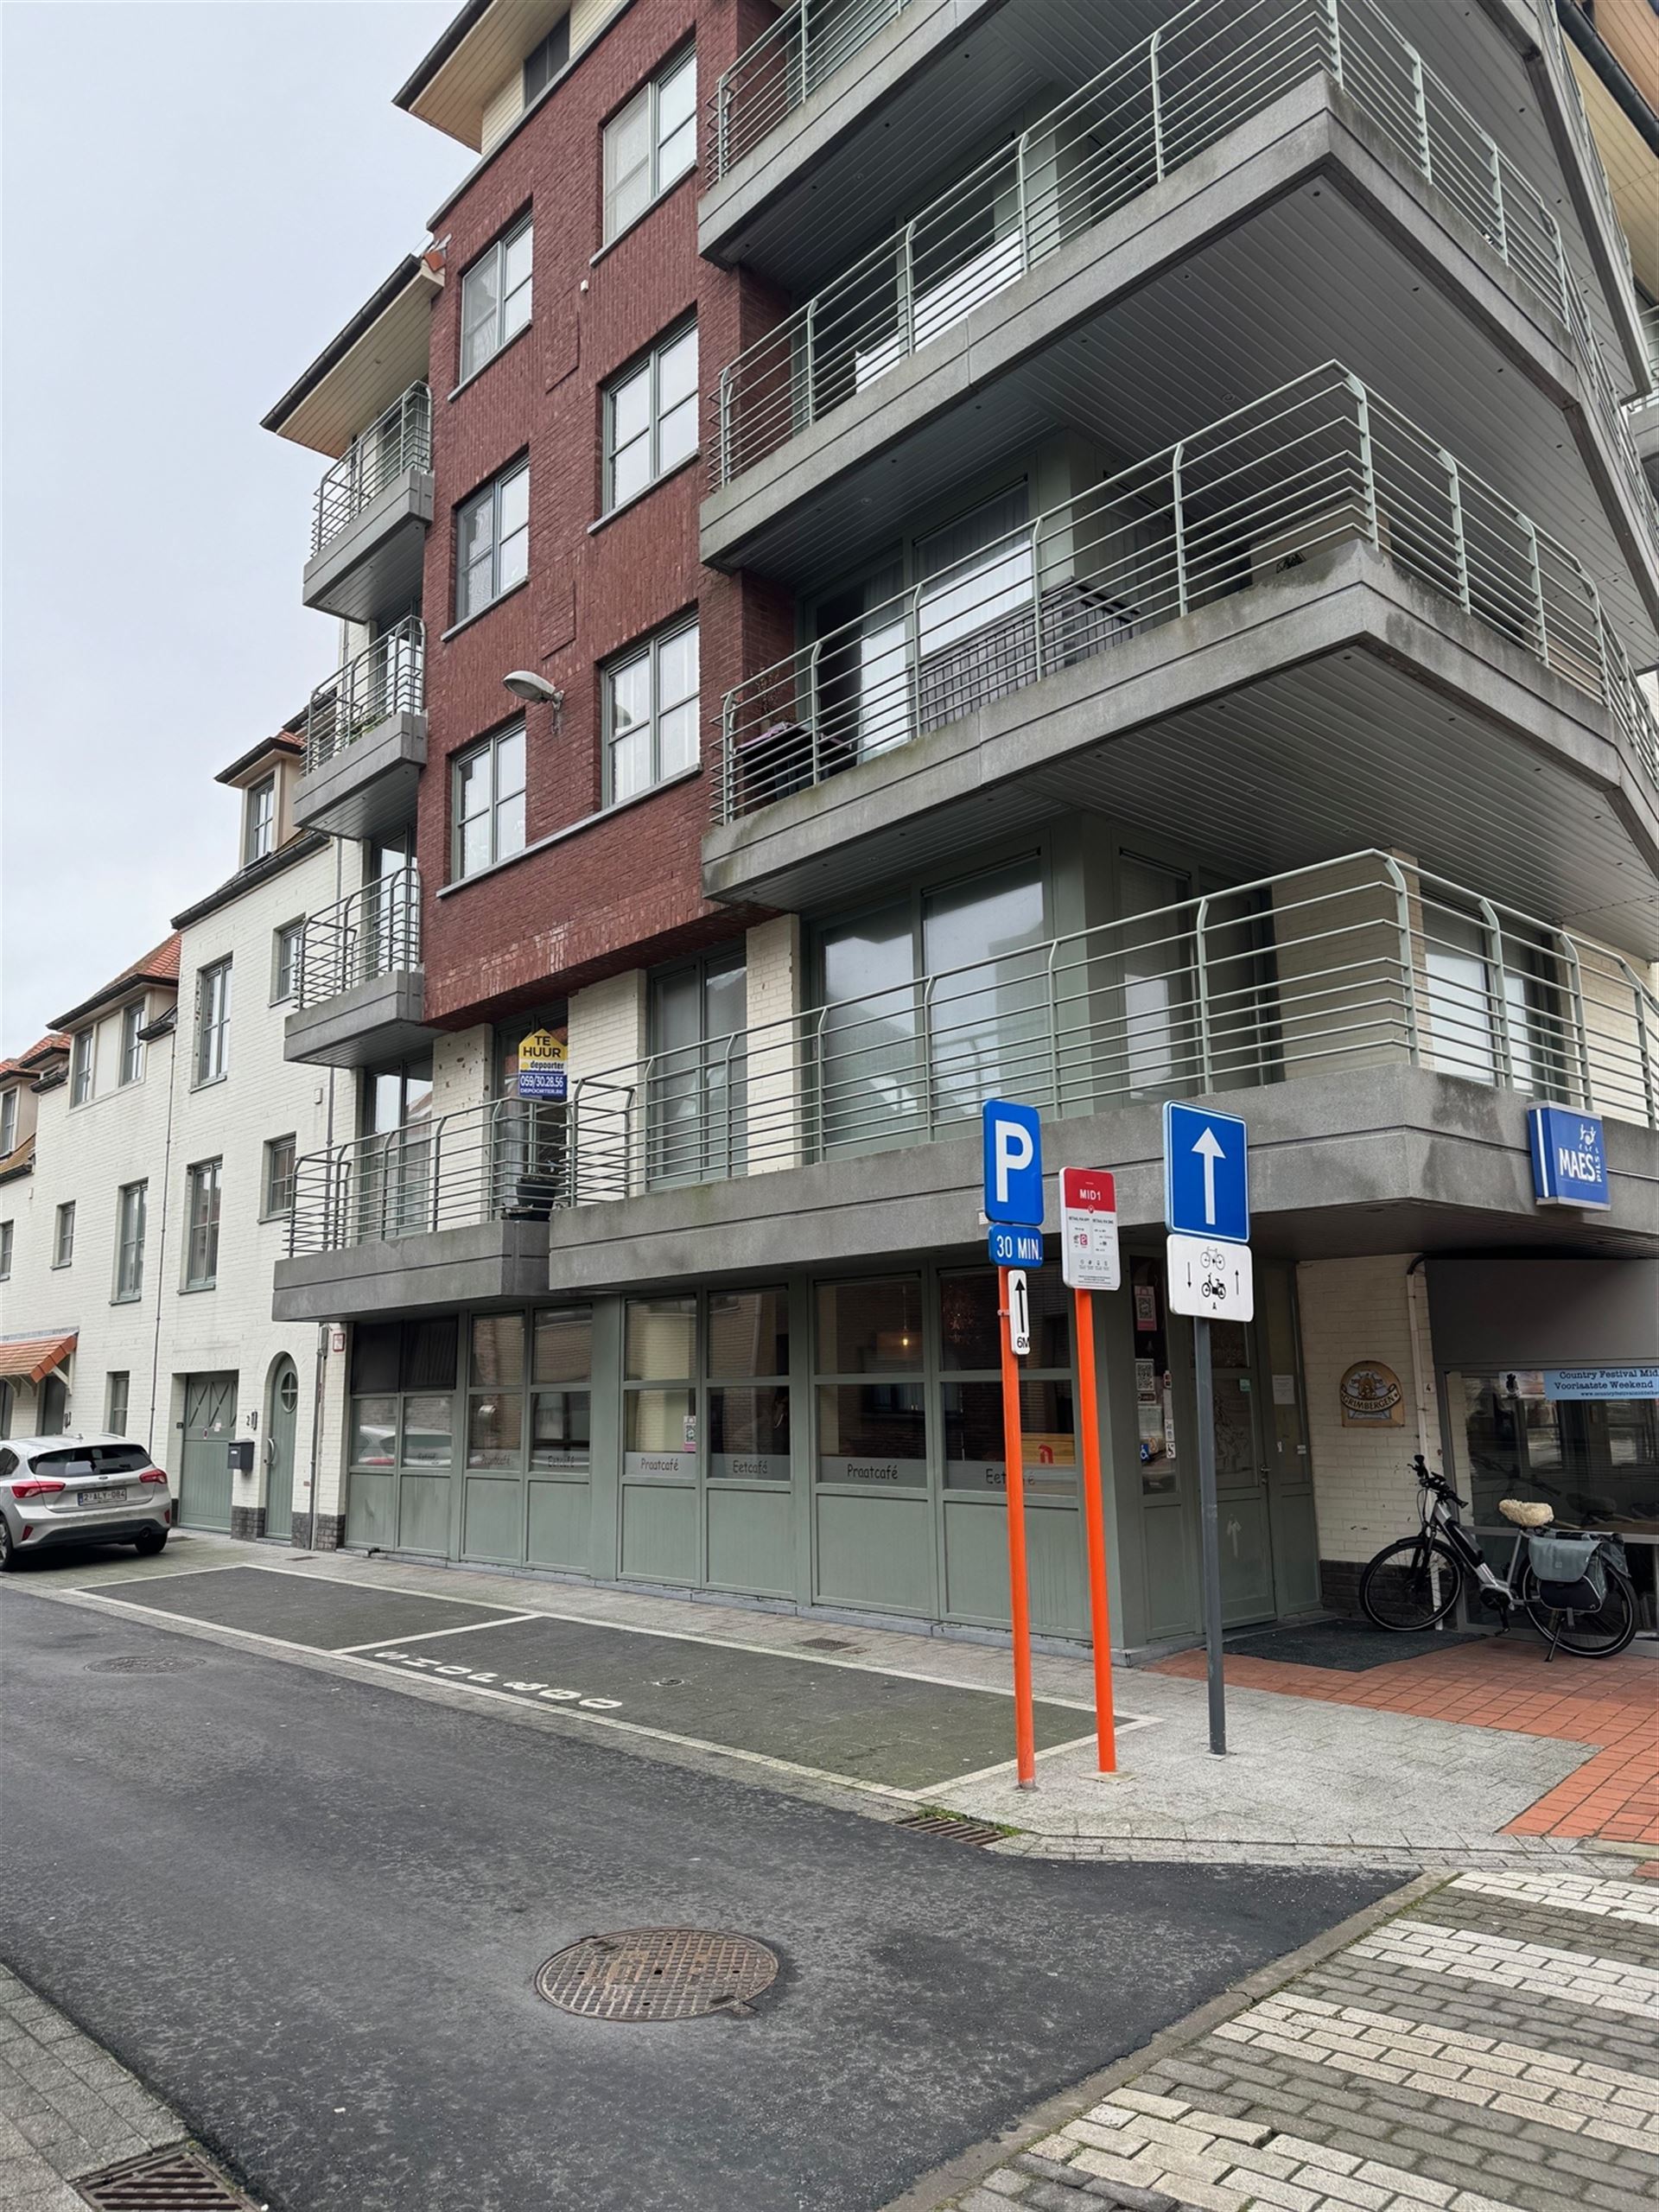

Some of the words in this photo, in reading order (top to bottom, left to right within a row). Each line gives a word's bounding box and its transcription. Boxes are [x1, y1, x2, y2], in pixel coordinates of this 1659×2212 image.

[534, 1035, 550, 1046] TE
[523, 1046, 562, 1058] HUUR
[530, 1060, 564, 1071] depoorter
[995, 1120, 1033, 1203] P
[1559, 1147, 1596, 1182] MAES
[1079, 1189, 1102, 1201] MID1
[996, 1236, 1013, 1258] 30
[1018, 1237, 1043, 1261] MIN.
[1560, 1370, 1598, 1380] Country
[1599, 1370, 1638, 1379] Festival
[1554, 1382, 1608, 1390] Voorlaatste
[1610, 1380, 1654, 1389] Weekend
[1344, 1395, 1395, 1410] GRIMBERGEN
[640, 1458, 679, 1471] Praatcafé
[733, 1459, 768, 1474] Eetcafé
[847, 1464, 898, 1480] Praatcafé
[986, 1468, 1035, 1485] Eeté
[373, 1651, 499, 1683] SHOP
[537, 1688, 623, 1709] GO
